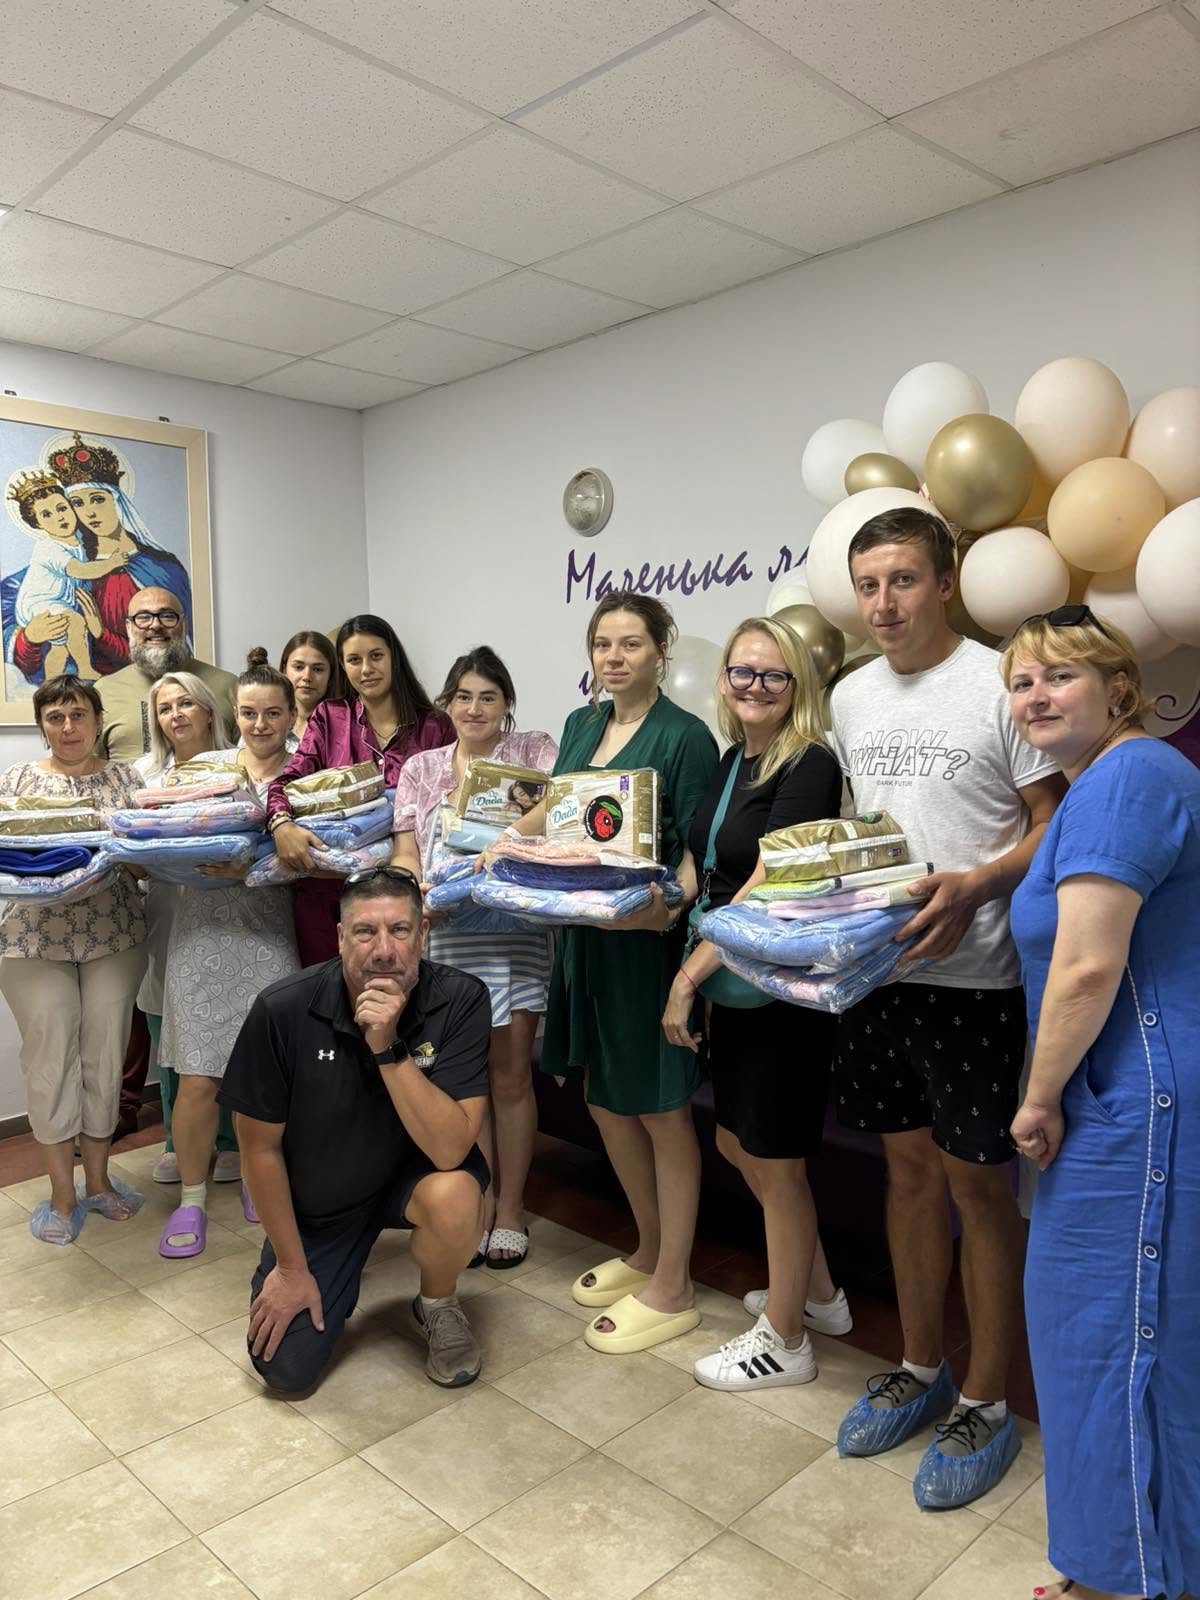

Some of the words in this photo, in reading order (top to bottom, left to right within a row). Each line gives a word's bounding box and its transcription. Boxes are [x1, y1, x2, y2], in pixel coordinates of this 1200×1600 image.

[858, 729, 948, 759] NOW
[850, 746, 971, 780] WHAT?
[476, 796, 503, 807] Dada
[552, 806, 578, 824] Dada
